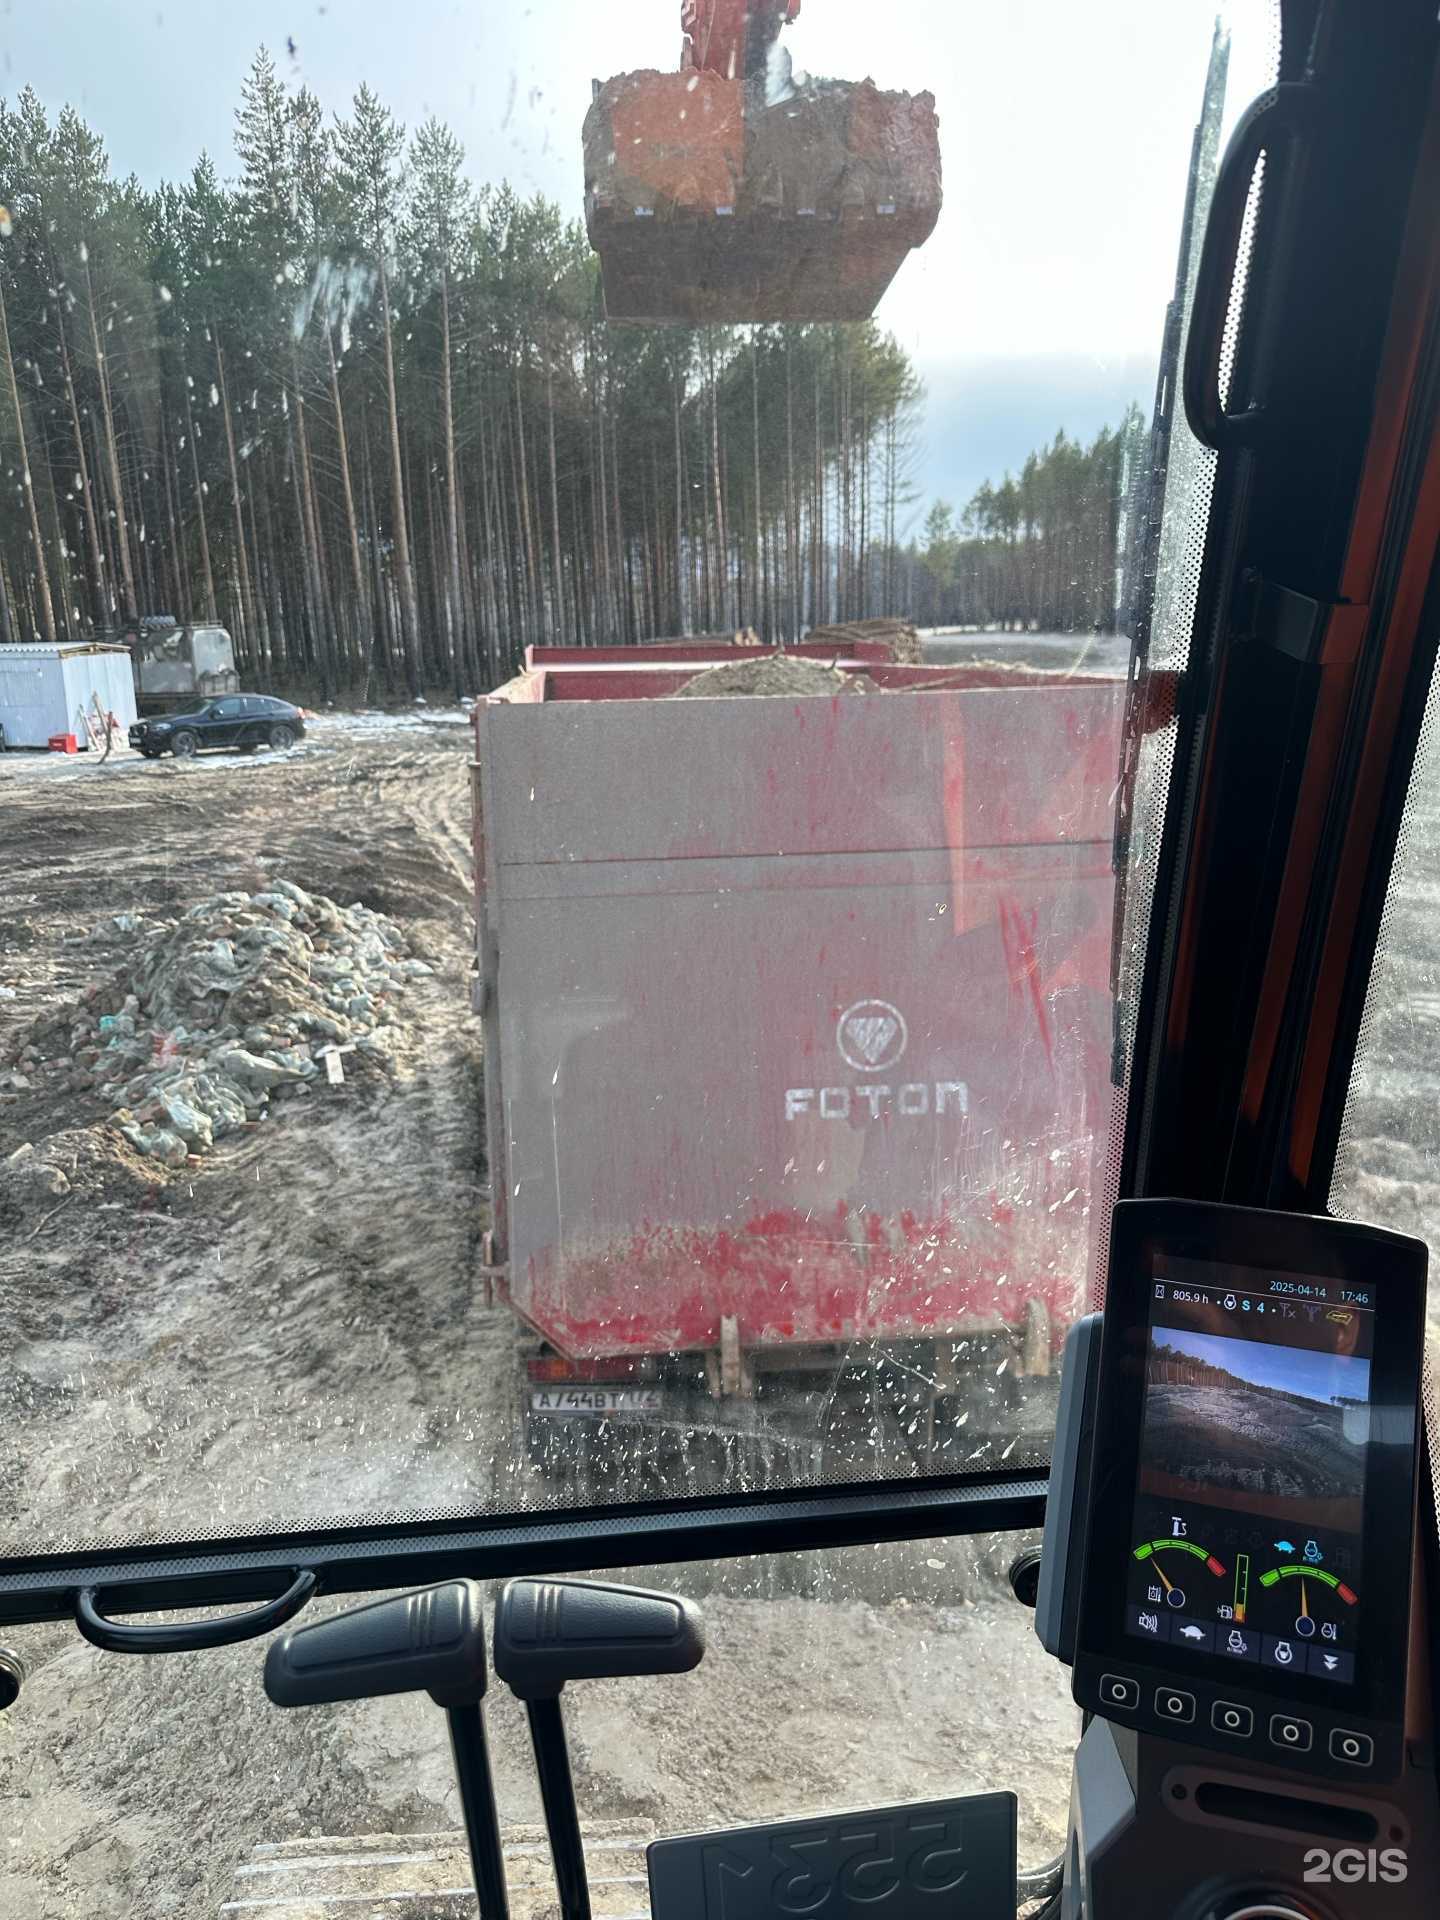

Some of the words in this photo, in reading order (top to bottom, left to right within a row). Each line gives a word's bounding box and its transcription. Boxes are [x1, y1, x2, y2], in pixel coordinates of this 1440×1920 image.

[784, 1081, 969, 1121] FOTON
[1172, 1289, 1200, 1303] 805.9
[1202, 1293, 1209, 1304] h
[1269, 1280, 1327, 1298] 2025-04-14
[1341, 1290, 1369, 1304] 17:46
[1241, 1299, 1251, 1312] S
[1256, 1301, 1265, 1313] 4
